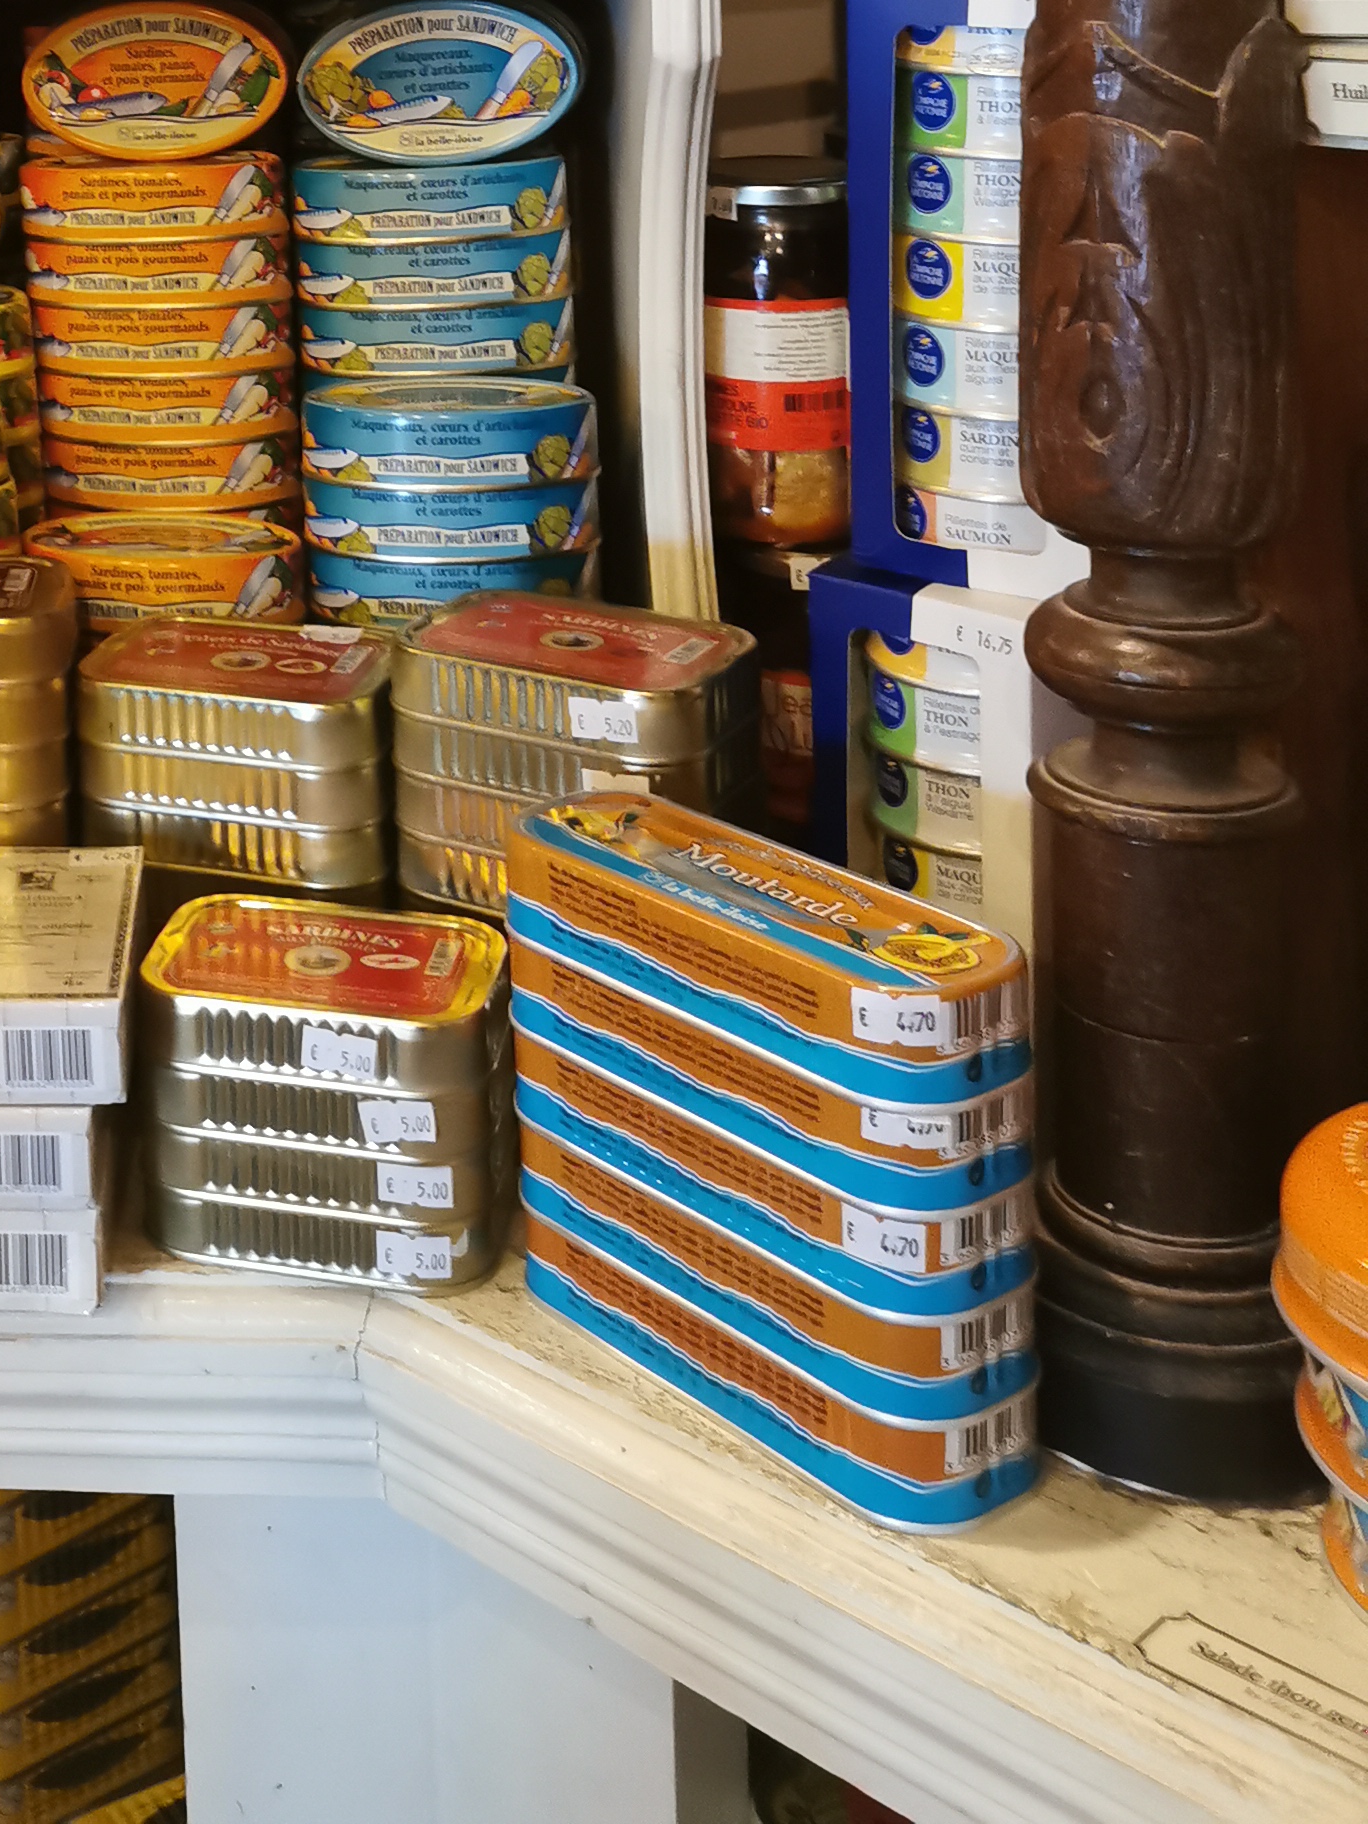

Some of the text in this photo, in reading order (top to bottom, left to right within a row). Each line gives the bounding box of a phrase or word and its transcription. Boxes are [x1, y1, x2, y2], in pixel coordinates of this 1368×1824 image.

[427, 17, 454, 34] pour
[456, 15, 518, 44] SANDWICH
[960, 430, 1019, 447] SARDIN
[944, 526, 1012, 546] SAUMON
[925, 708, 969, 728] THON
[926, 779, 970, 800] THON
[667, 841, 859, 927] Moutarde
